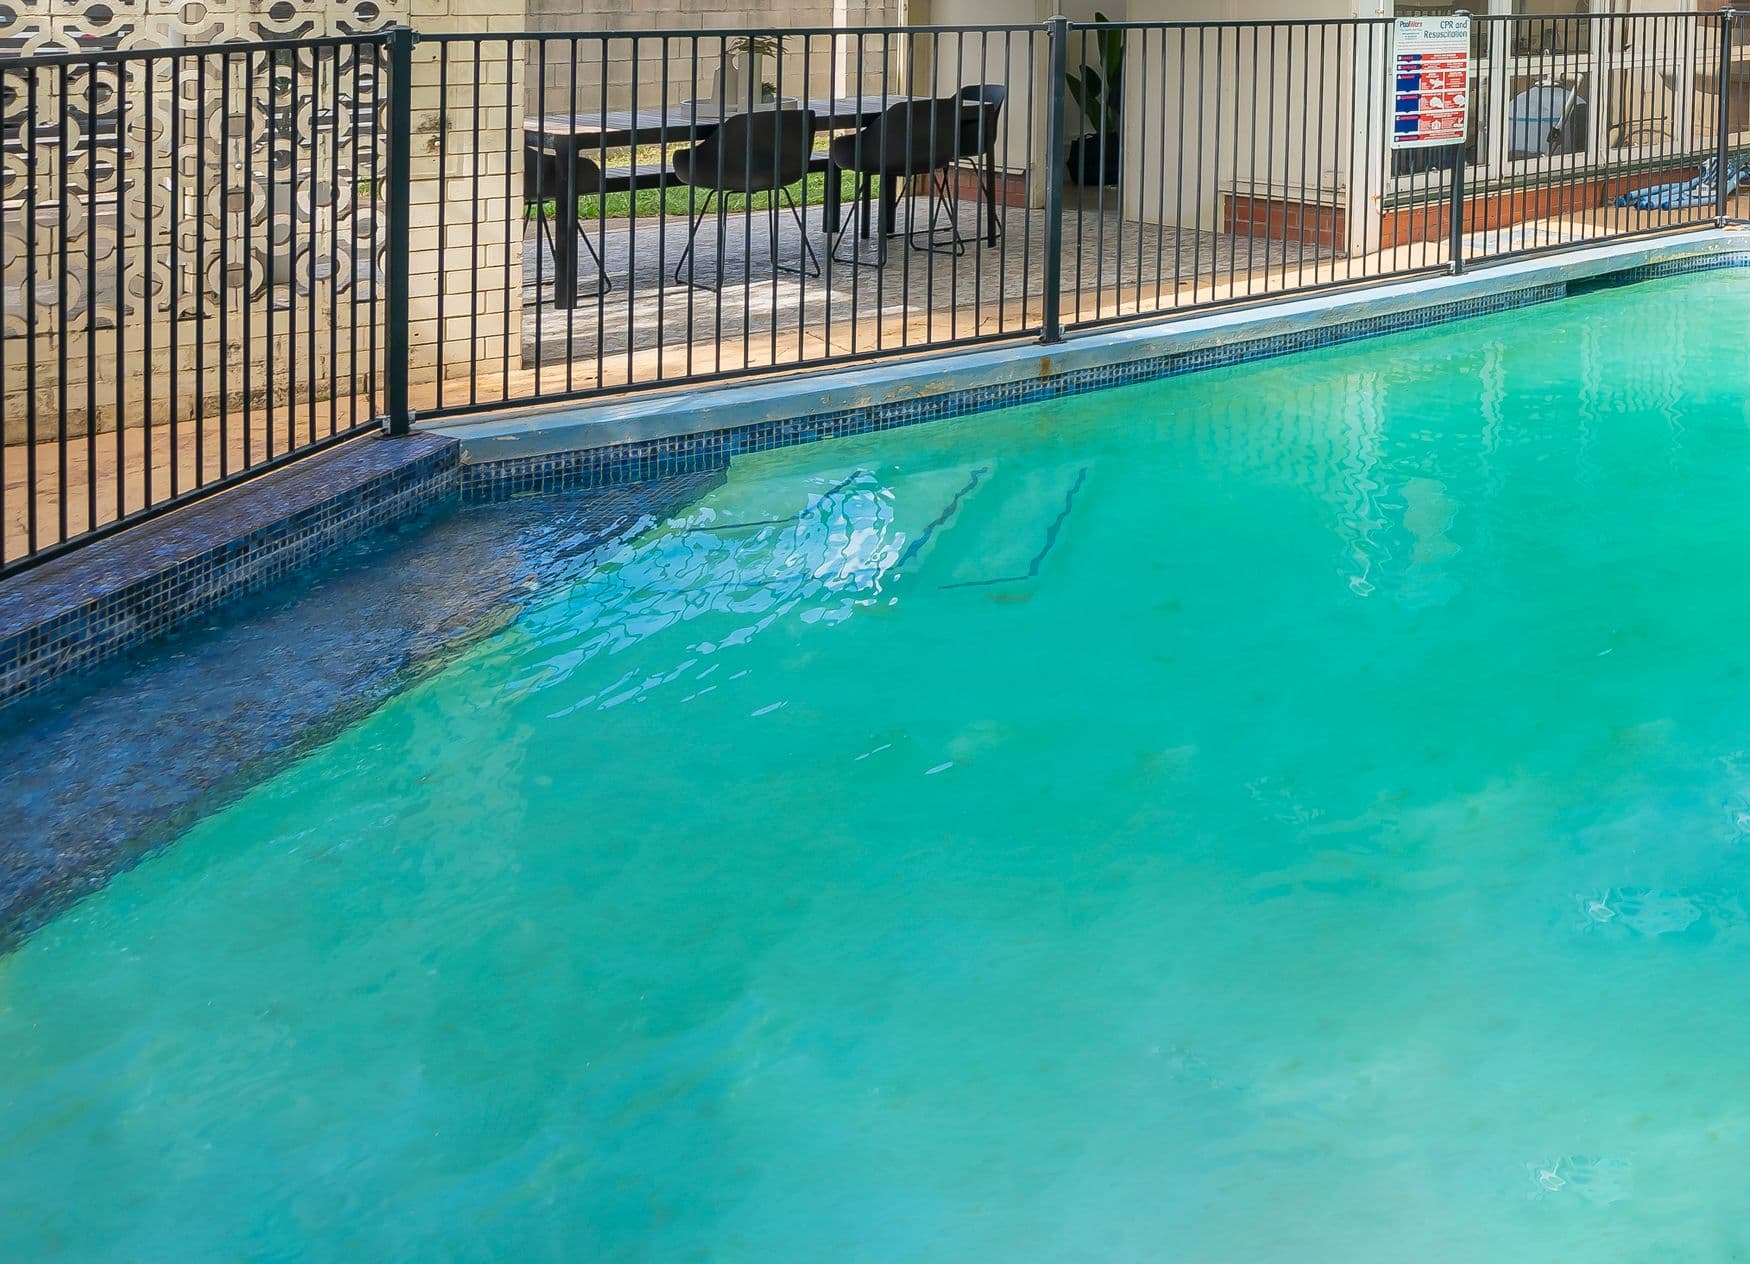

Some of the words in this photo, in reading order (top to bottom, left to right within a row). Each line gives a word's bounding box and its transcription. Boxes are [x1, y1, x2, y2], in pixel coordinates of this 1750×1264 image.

[1440, 20, 1453, 29] CPR
[1455, 20, 1467, 29] and
[1424, 30, 1467, 38] Resuscitation
